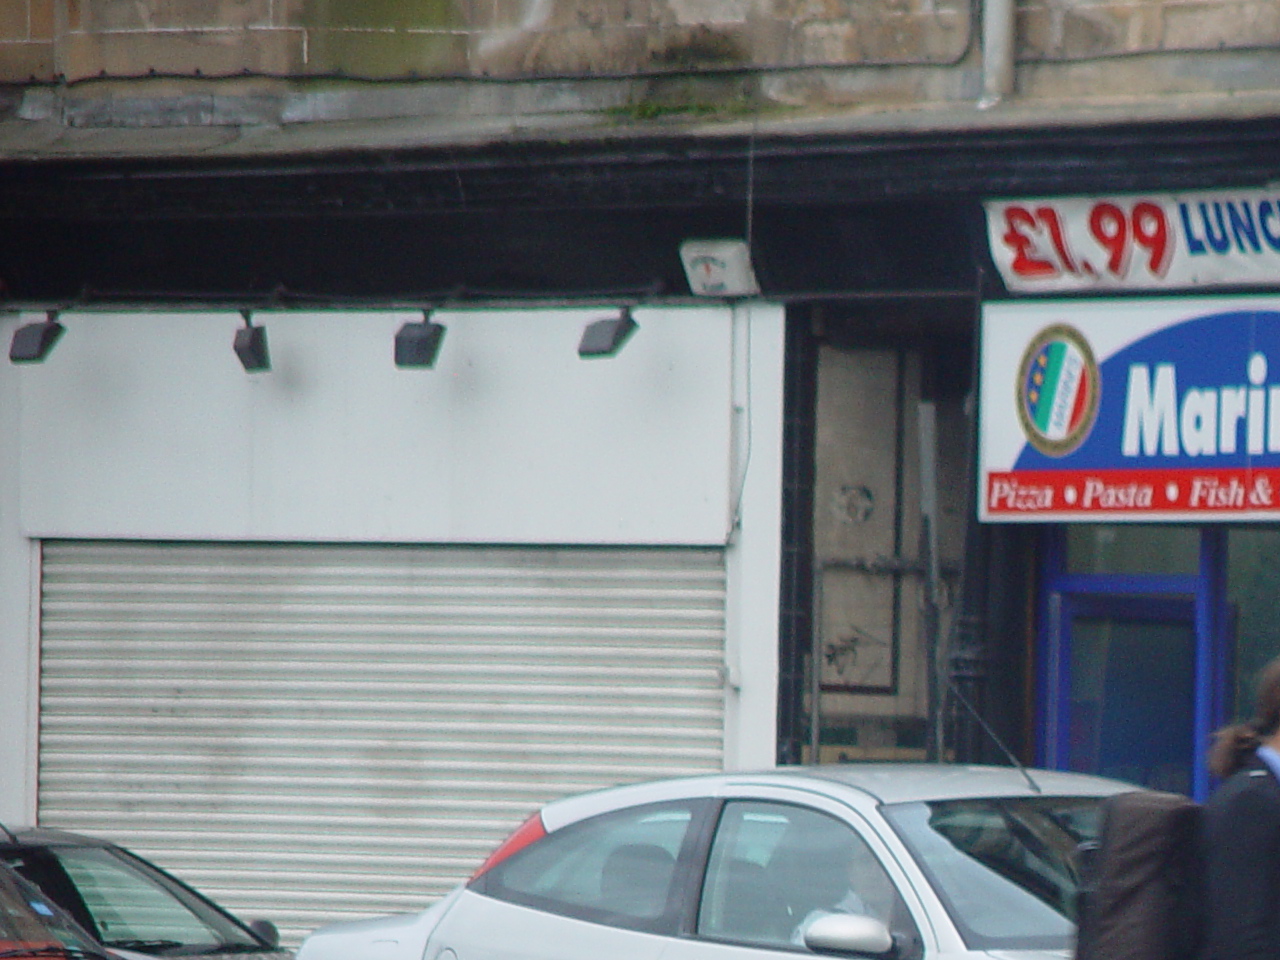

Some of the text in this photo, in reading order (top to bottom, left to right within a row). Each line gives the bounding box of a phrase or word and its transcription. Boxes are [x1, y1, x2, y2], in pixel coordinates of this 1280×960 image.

[1003, 202, 1174, 280] £1.99
[989, 478, 1054, 510] Pizza
[1082, 477, 1153, 509] Pasta
[1189, 477, 1245, 507] Fish
[1248, 477, 1272, 506] &
